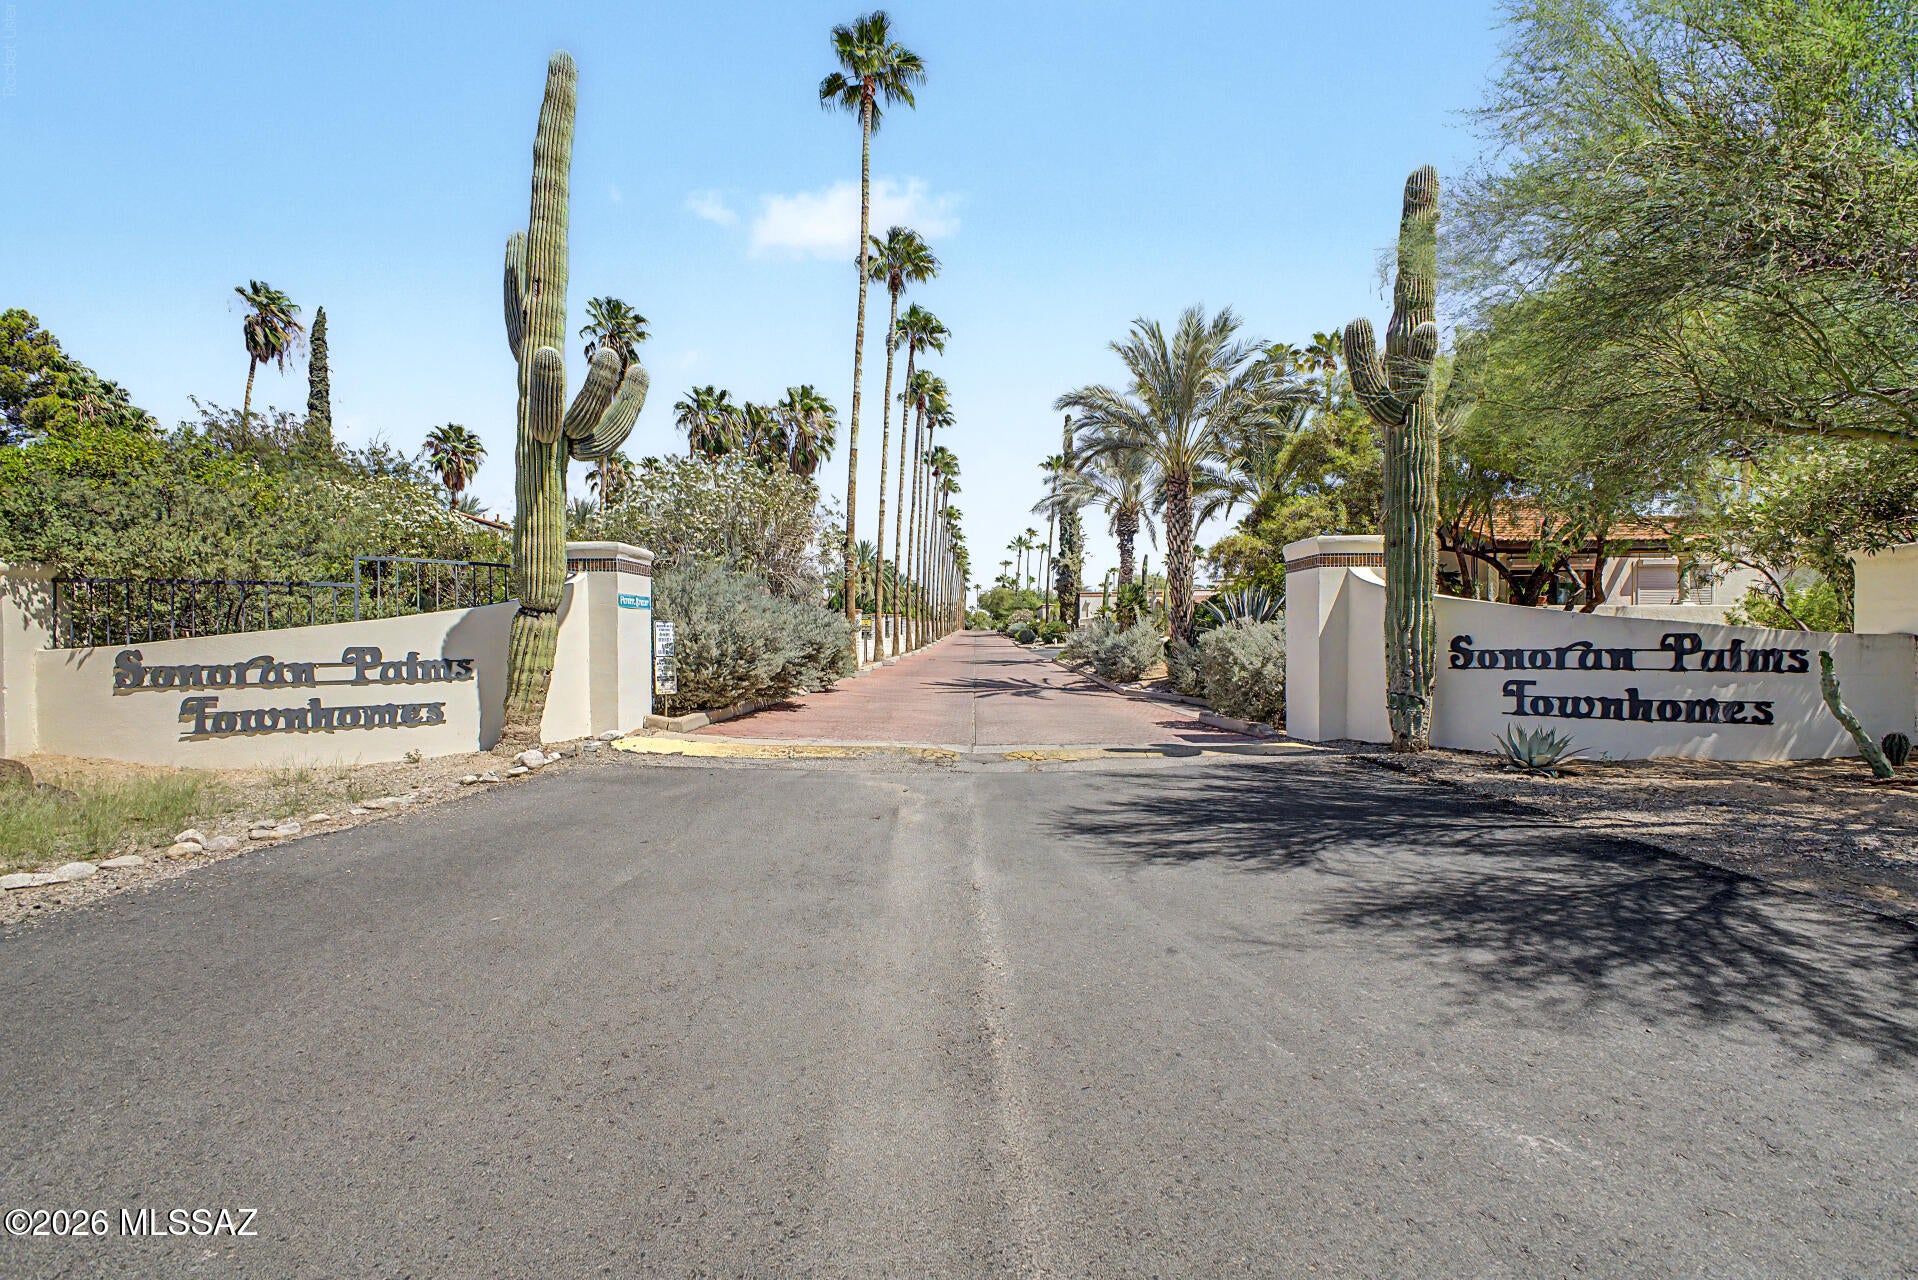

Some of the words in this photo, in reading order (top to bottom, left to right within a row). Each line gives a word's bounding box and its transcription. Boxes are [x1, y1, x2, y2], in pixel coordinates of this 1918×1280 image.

[114, 650, 316, 688] Sonoran
[342, 647, 474, 683] Palms
[1448, 635, 1635, 670] Sonoran
[1660, 633, 1809, 673] Palms
[179, 696, 446, 736] Townhomes
[1502, 680, 1774, 725] Townhomes
